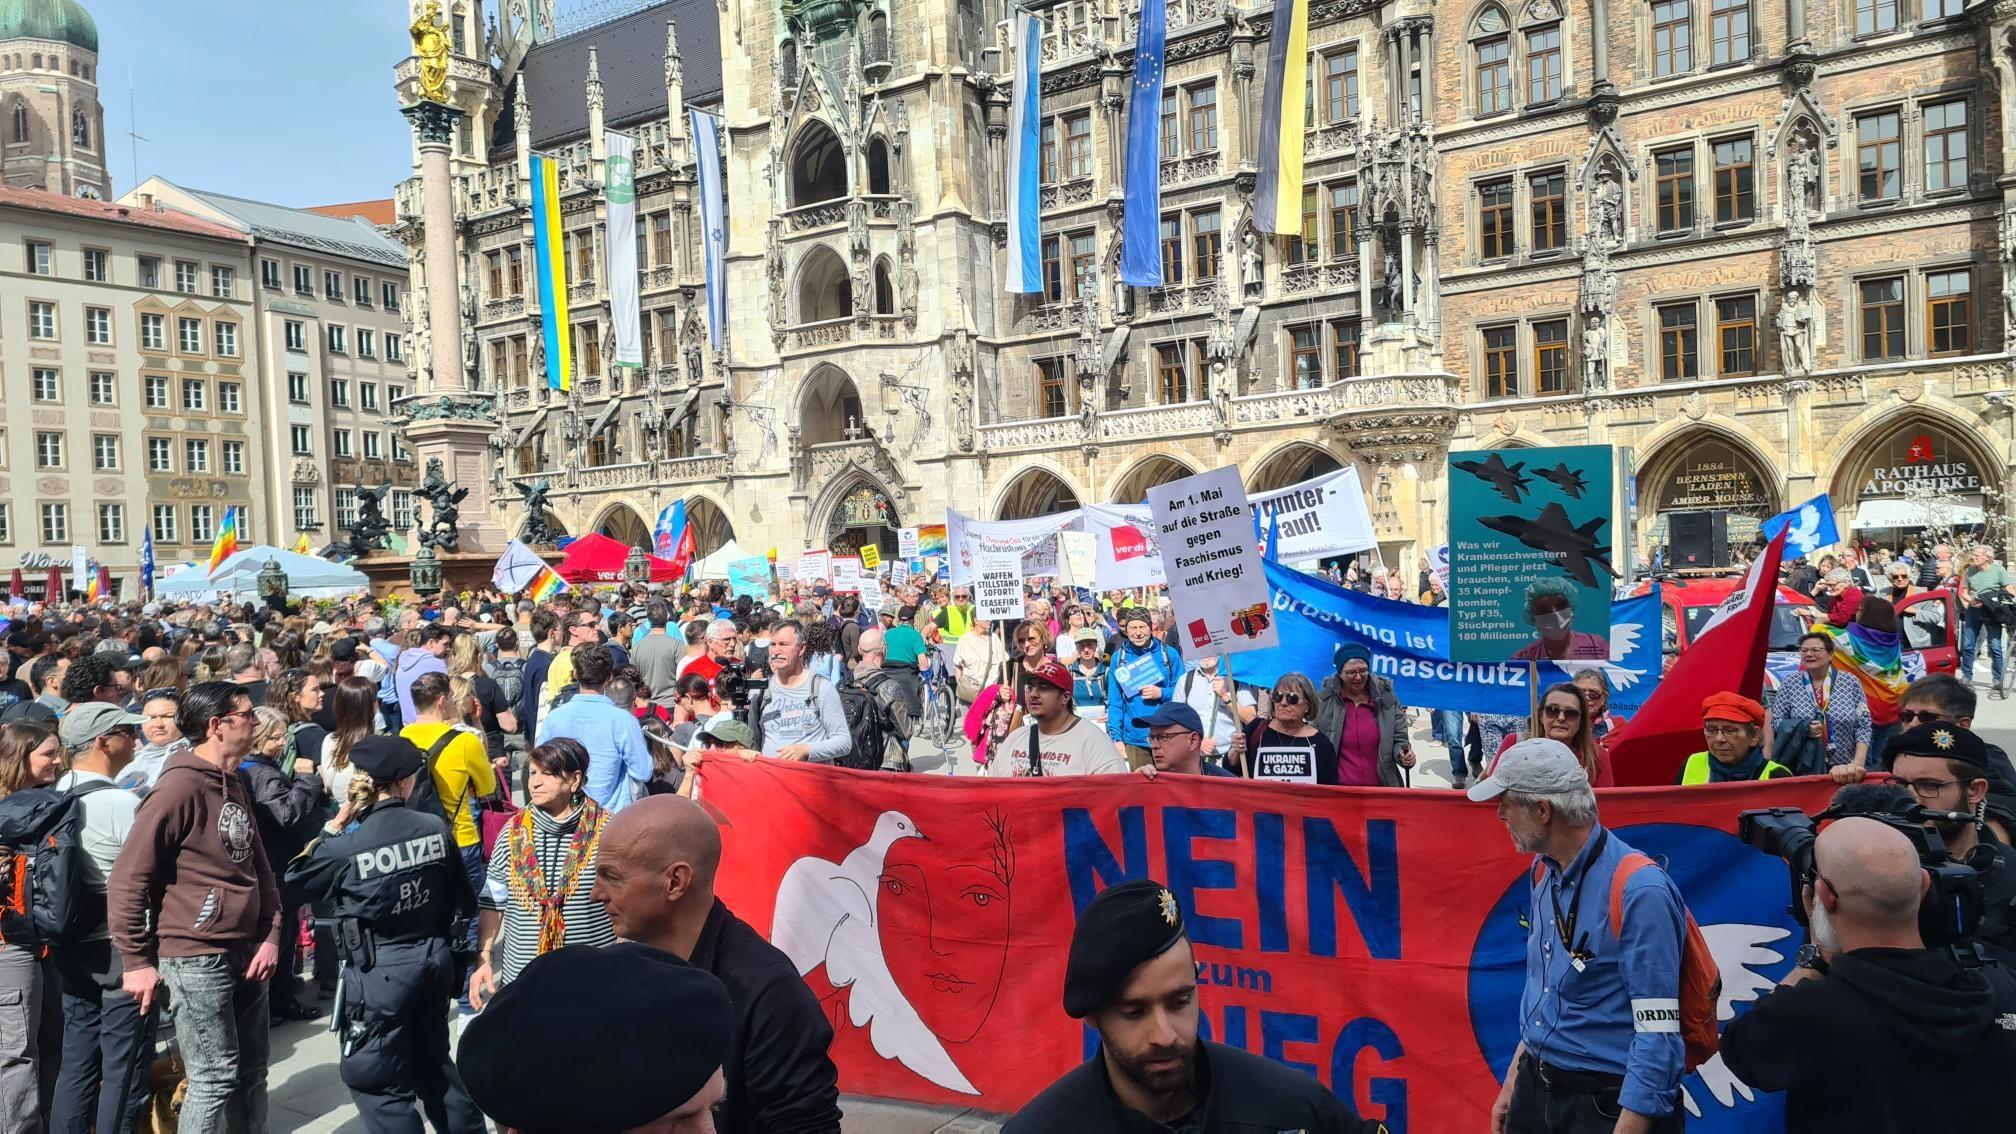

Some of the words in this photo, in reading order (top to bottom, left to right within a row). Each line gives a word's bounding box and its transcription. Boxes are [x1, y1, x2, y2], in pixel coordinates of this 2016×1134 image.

[1697, 462, 1724, 470] 1884
[1874, 462, 1967, 480] RATHAUS
[1676, 472, 1746, 484] BERNSTEIN
[1690, 482, 1732, 490] LADEN
[1863, 476, 1979, 494] APOTHEKE
[1169, 500, 1186, 512] Am
[1188, 494, 1199, 506] 1.
[1200, 487, 1223, 502] Mai
[1261, 487, 1324, 518] runter
[1671, 496, 1710, 505] AMBER
[1715, 493, 1756, 502] HOUSE
[1162, 520, 1178, 534] auf
[1181, 516, 1198, 528] die
[1200, 506, 1241, 523] Straße
[1186, 530, 1222, 548] gegen
[1456, 542, 1480, 550] Was
[1483, 541, 1500, 549] wir
[1175, 546, 1243, 568] Faschismus
[1456, 552, 1567, 560] Krankenschwestern
[1457, 564, 1476, 572] und
[1480, 564, 1520, 572] Pfleger
[1522, 562, 1547, 572] jetzt
[982, 572, 1014, 580] WAFFEN
[1185, 573, 1204, 586] und
[1206, 564, 1244, 582] Krieg!
[1457, 576, 1510, 584] brauchen,
[1514, 574, 1536, 582] sind
[978, 580, 1020, 588] STILLSTAND
[984, 588, 1014, 596] SOFORT!
[1457, 588, 1470, 596] 35
[1474, 586, 1512, 596] Kampf-
[980, 598, 1020, 607] CEASEFIRE
[1457, 610, 1476, 618] Typ
[1480, 610, 1503, 618] F35,
[1457, 621, 1516, 630] Stückpreis
[1406, 631, 1436, 650] ist
[1458, 632, 1477, 640] 180
[1480, 632, 1528, 640] Millionen
[1532, 632, 1540, 640] €
[1262, 754, 1306, 764] UKRAINE
[1264, 764, 1270, 774] &
[1273, 764, 1304, 774] GAZA:
[356, 834, 446, 880] POLIZEI
[400, 876, 422, 900] BY
[1062, 806, 1402, 960] NEIN
[391, 889, 430, 915] 4422
[1195, 962, 1272, 993] zum
